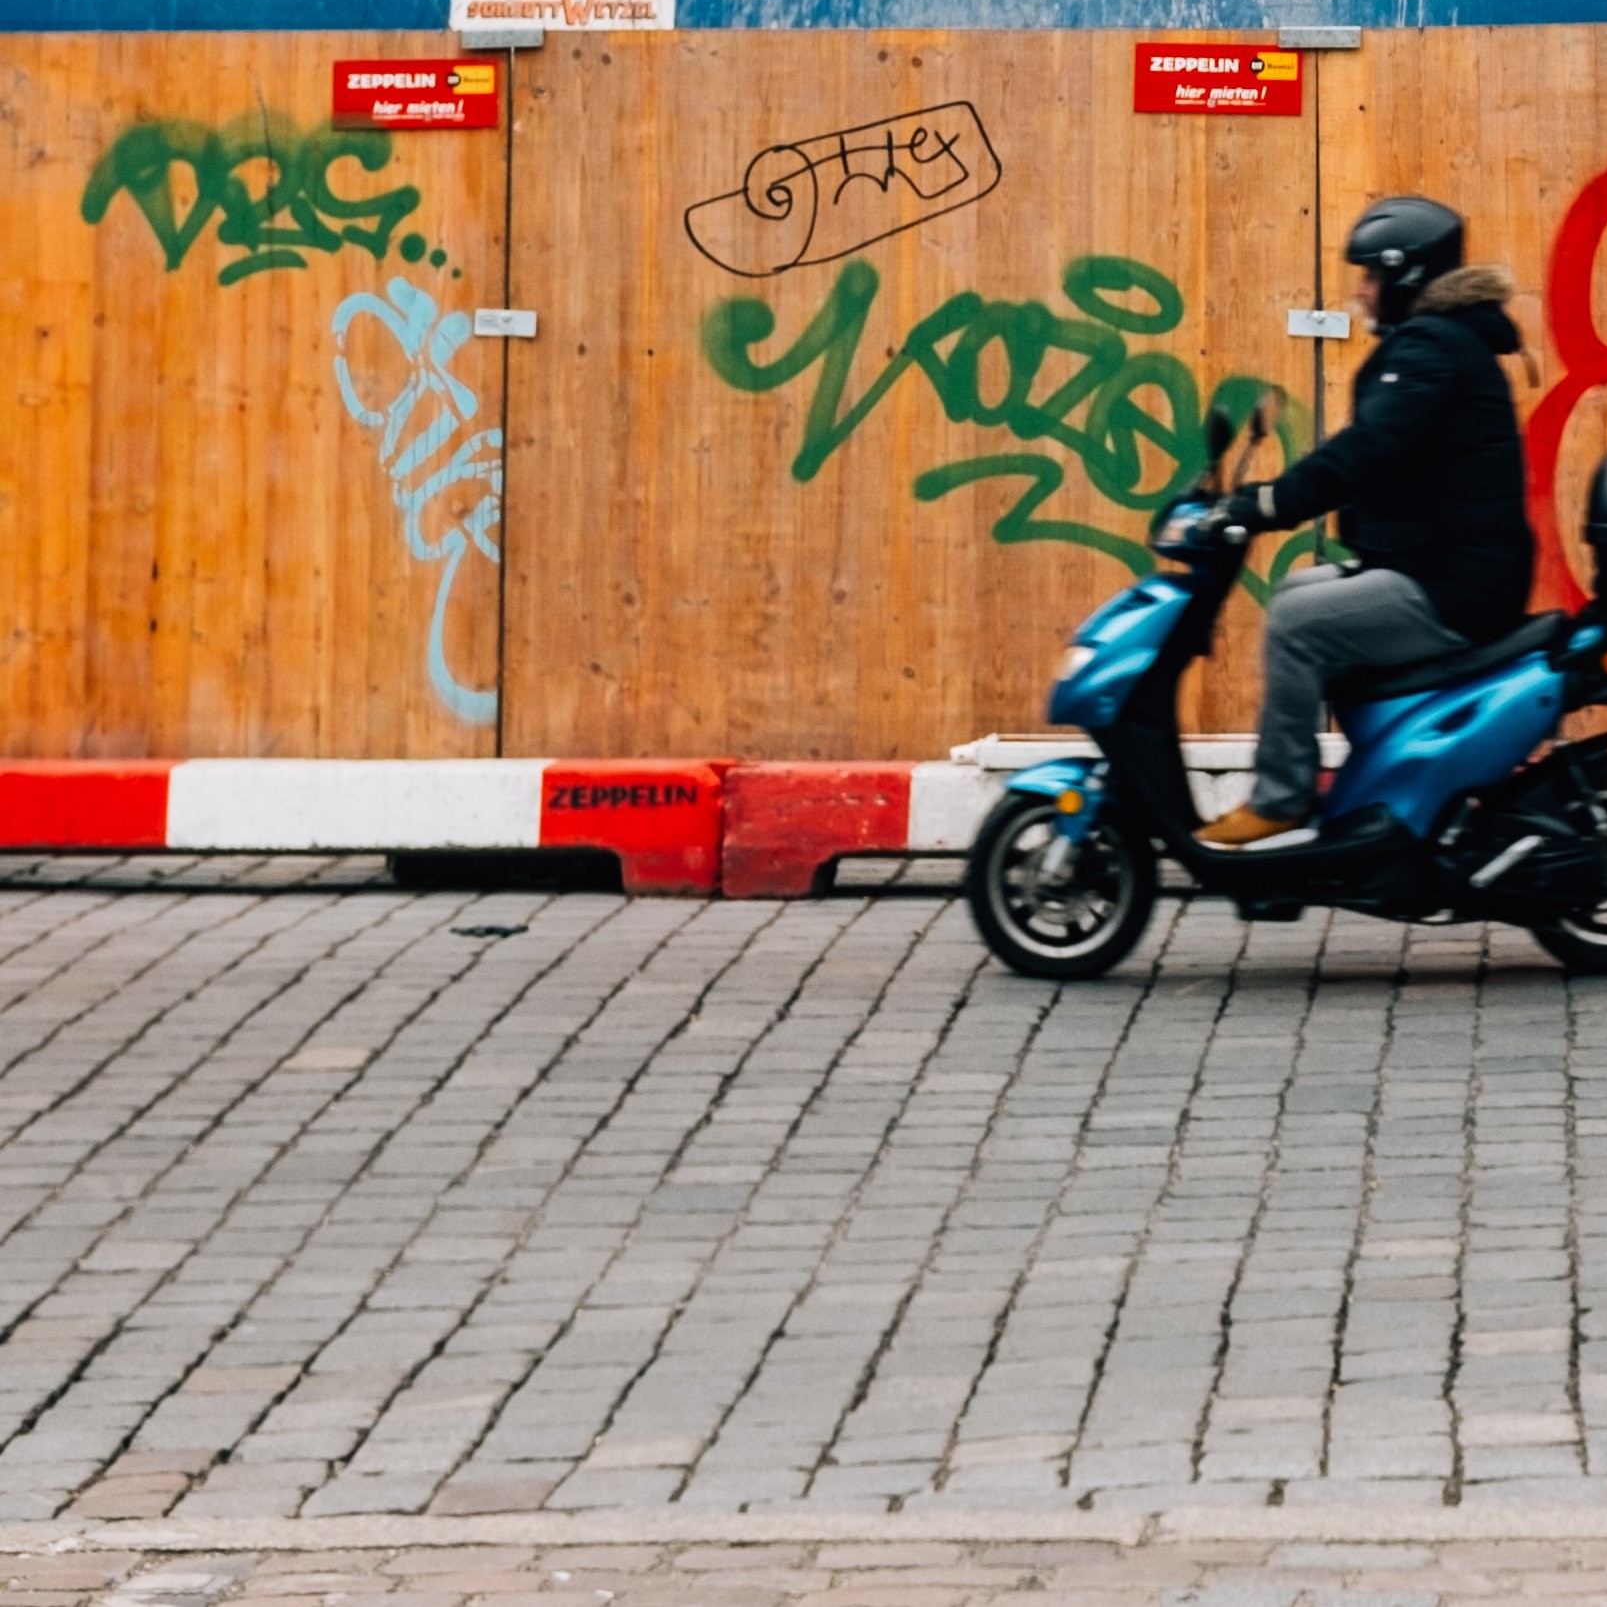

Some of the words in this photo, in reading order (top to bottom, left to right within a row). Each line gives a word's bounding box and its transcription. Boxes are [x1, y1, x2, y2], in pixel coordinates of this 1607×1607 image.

[1150, 57, 1240, 73] ZEPPELIN
[348, 73, 436, 89] ZEPPELIN
[1175, 84, 1206, 99] hier
[373, 100, 403, 115] hier
[549, 785, 698, 809] ZEPPELIN
